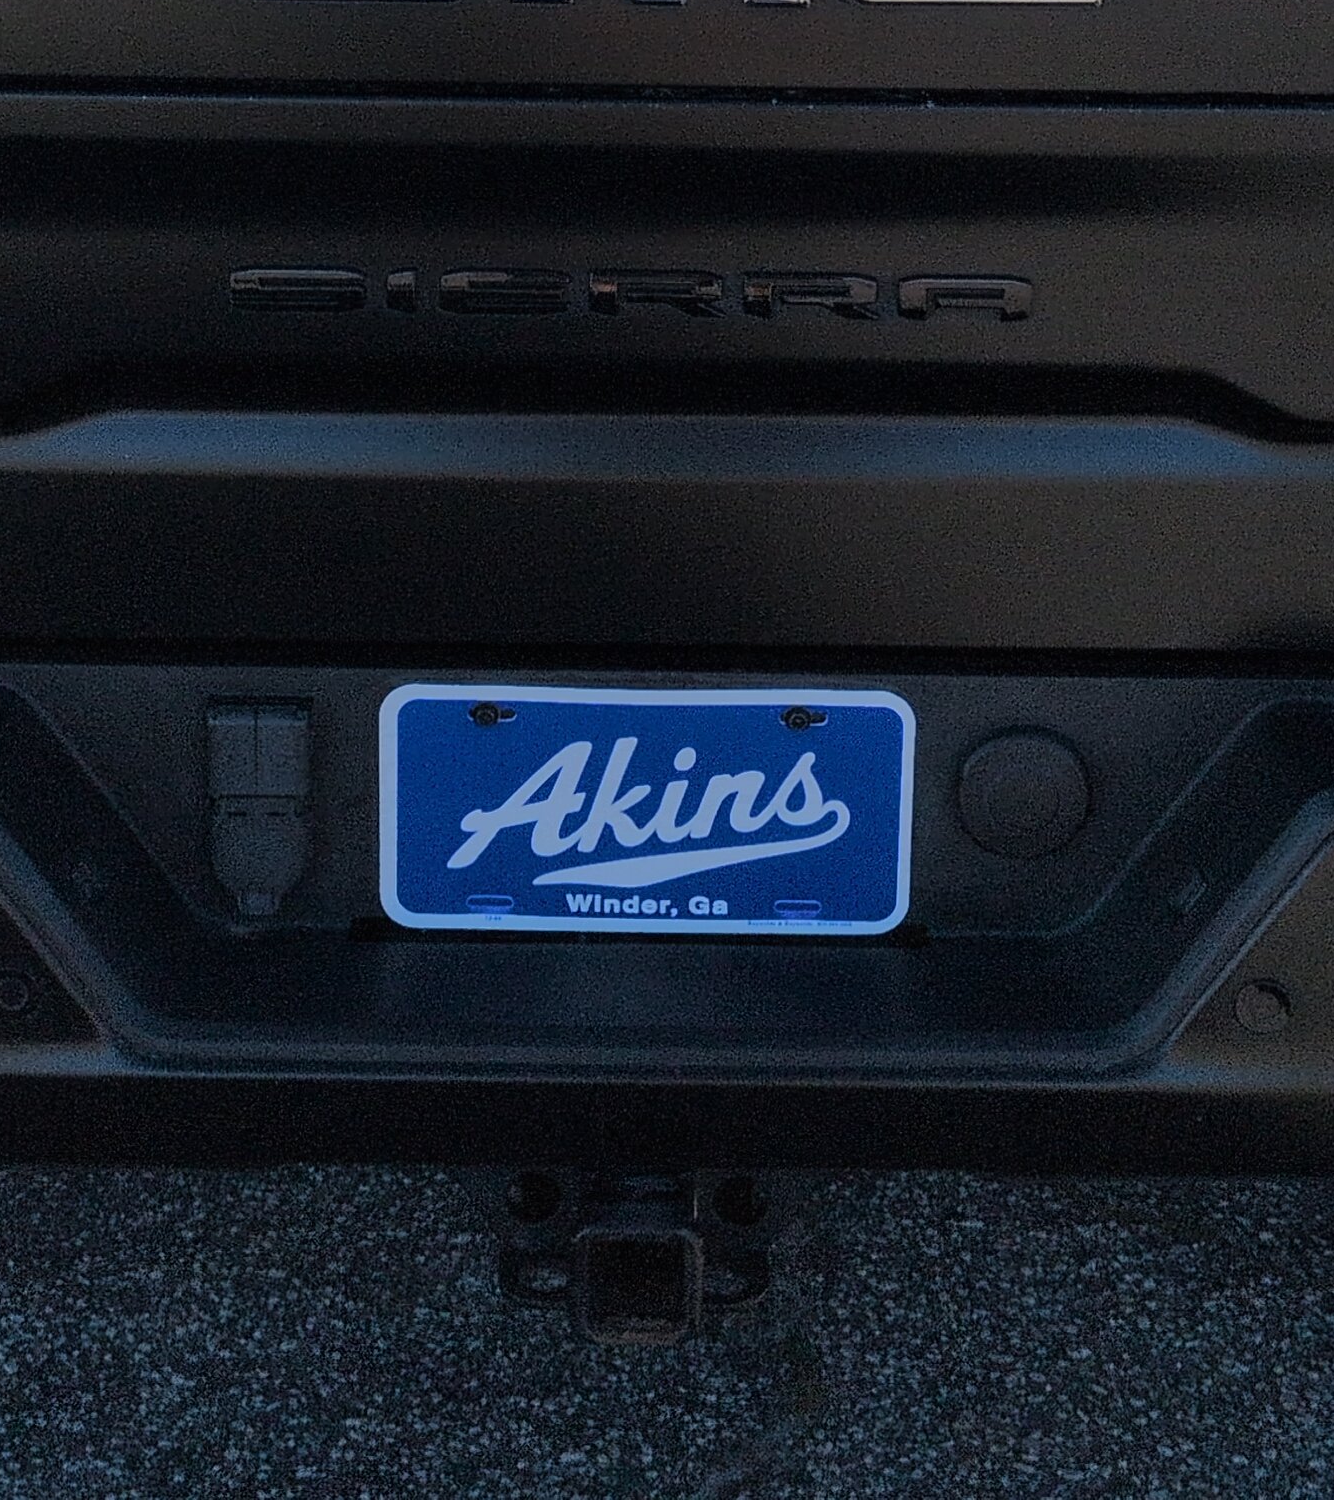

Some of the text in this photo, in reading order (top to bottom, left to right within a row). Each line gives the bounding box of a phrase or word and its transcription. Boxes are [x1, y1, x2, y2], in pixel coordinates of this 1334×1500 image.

[228, 267, 1035, 321] SIERRA
[447, 736, 850, 887] Akins
[566, 893, 728, 917] Winder, Ga
